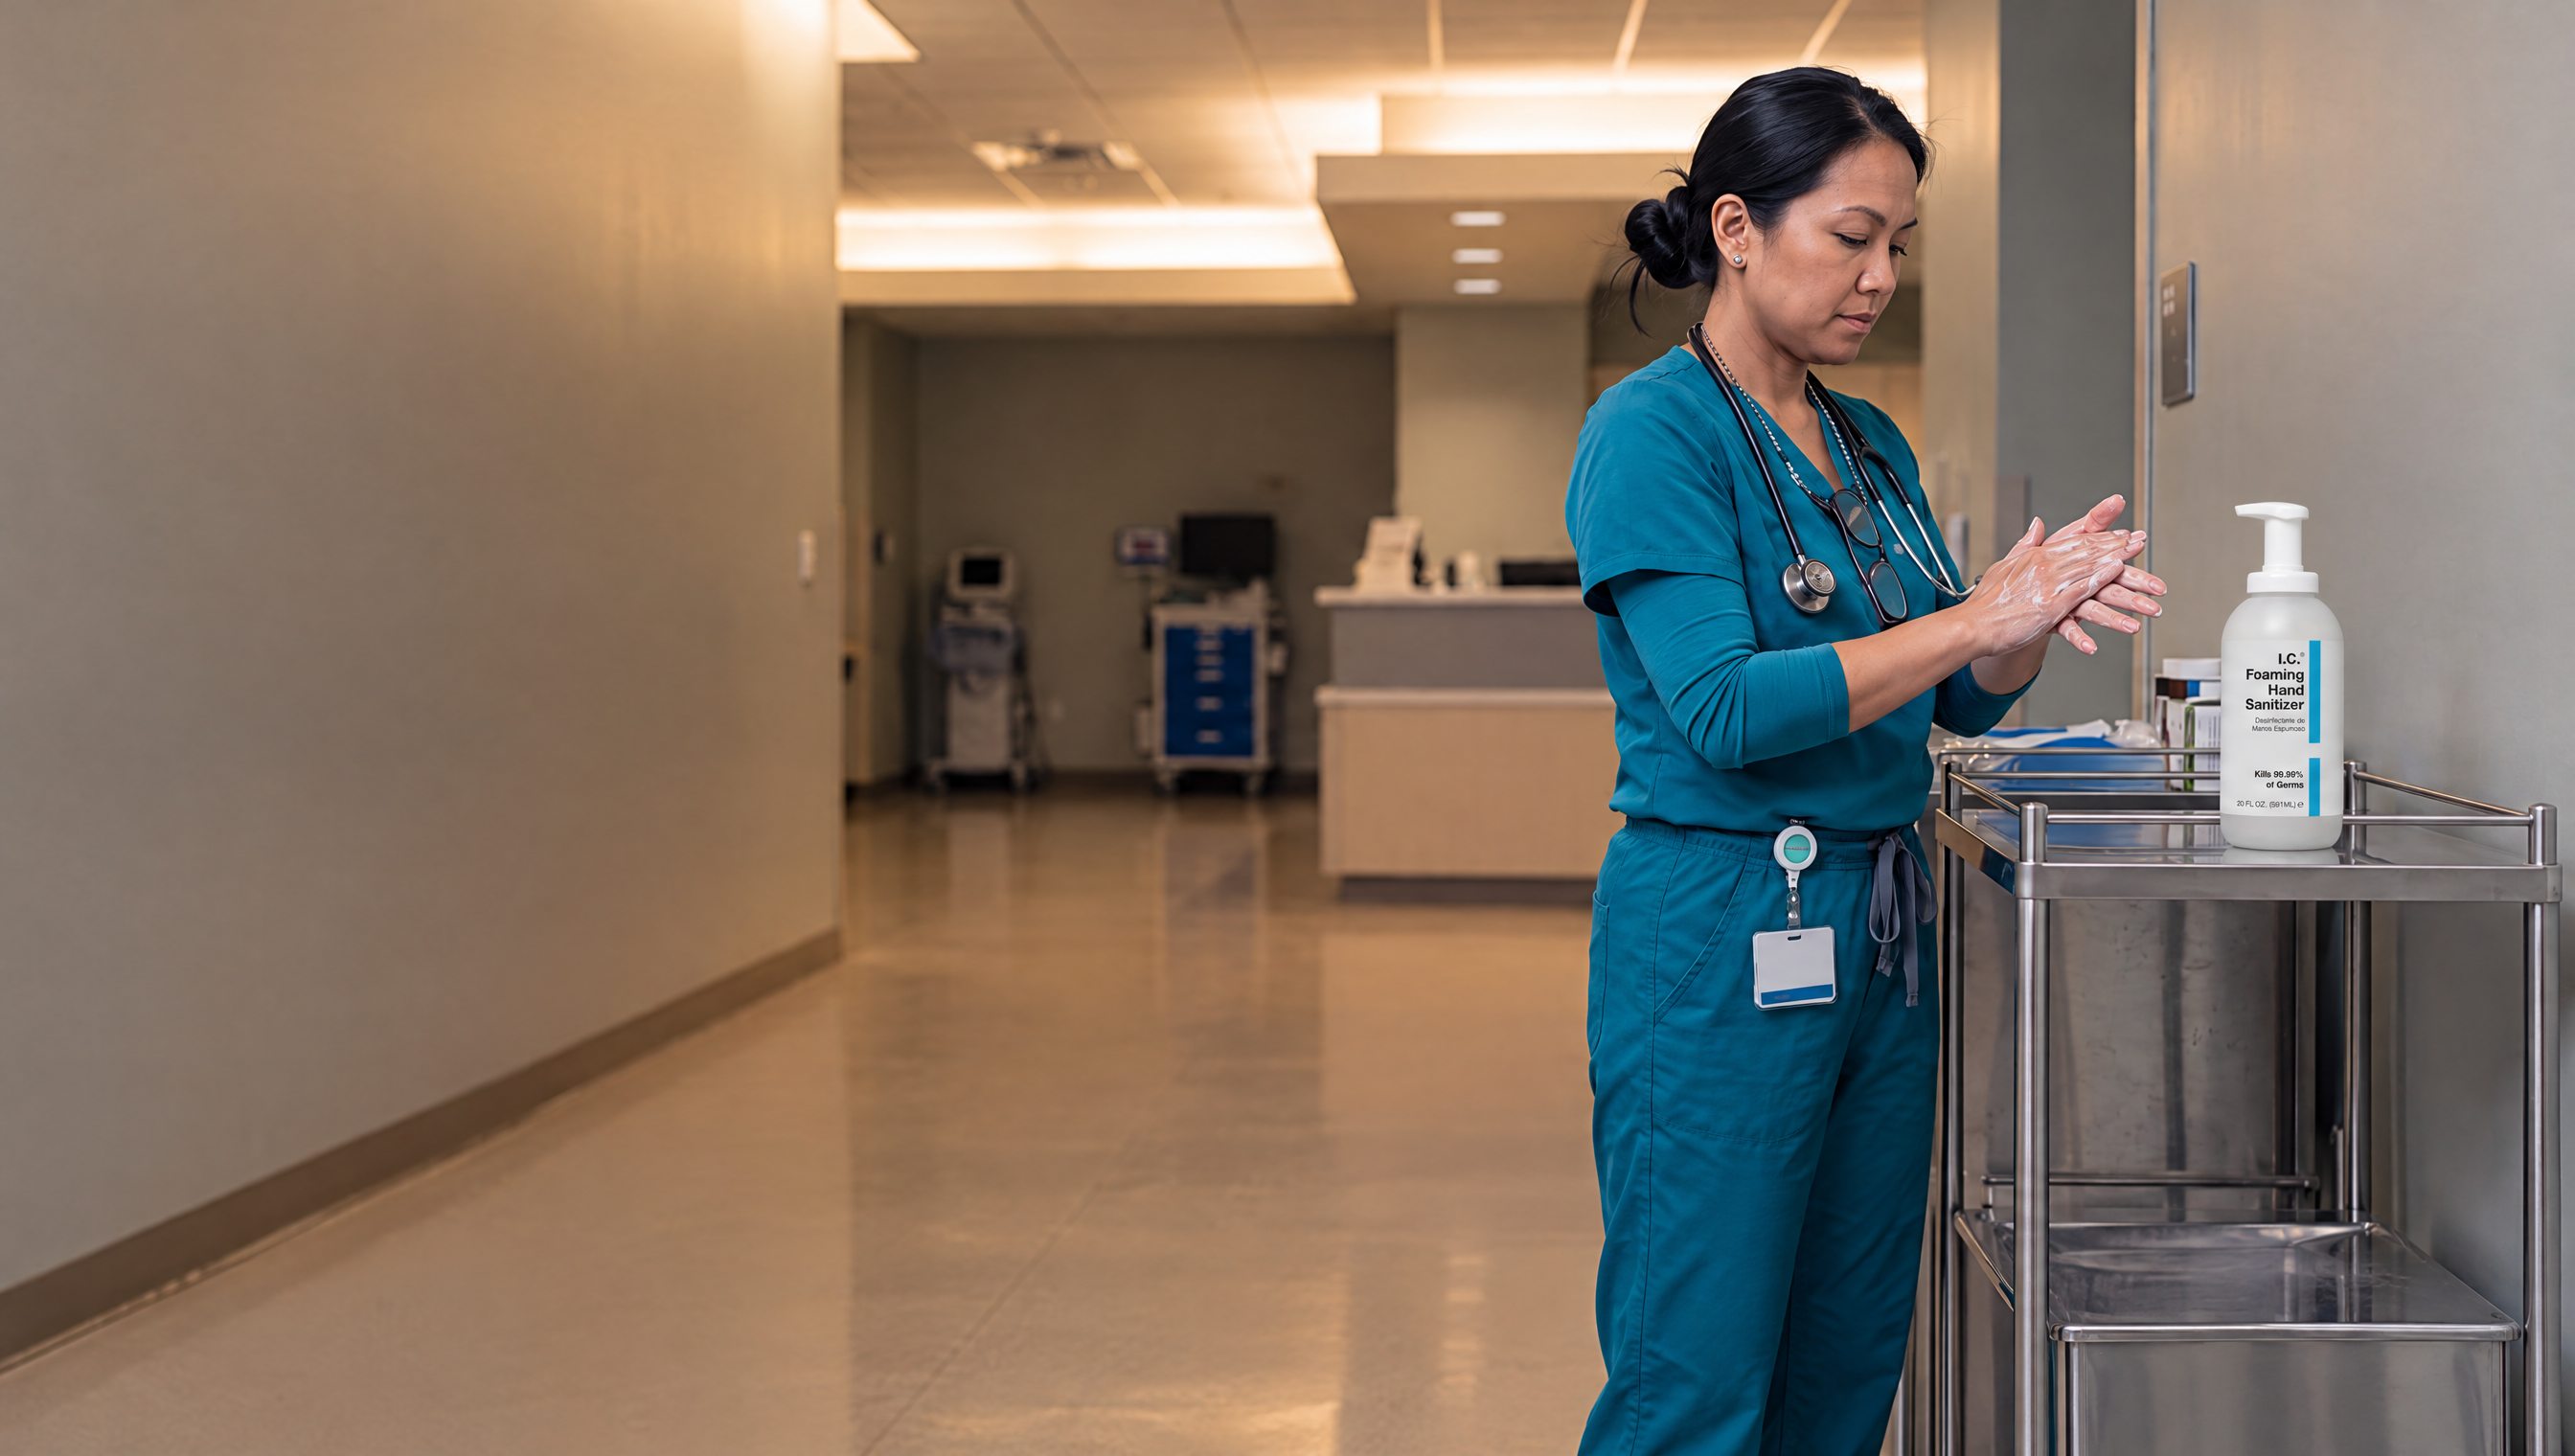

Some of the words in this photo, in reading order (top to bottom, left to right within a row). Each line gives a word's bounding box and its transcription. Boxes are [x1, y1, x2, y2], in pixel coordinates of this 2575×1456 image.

[2245, 668, 2305, 683] Foaming
[2267, 684, 2305, 695] Hand
[2245, 698, 2305, 710] Sanitizer
